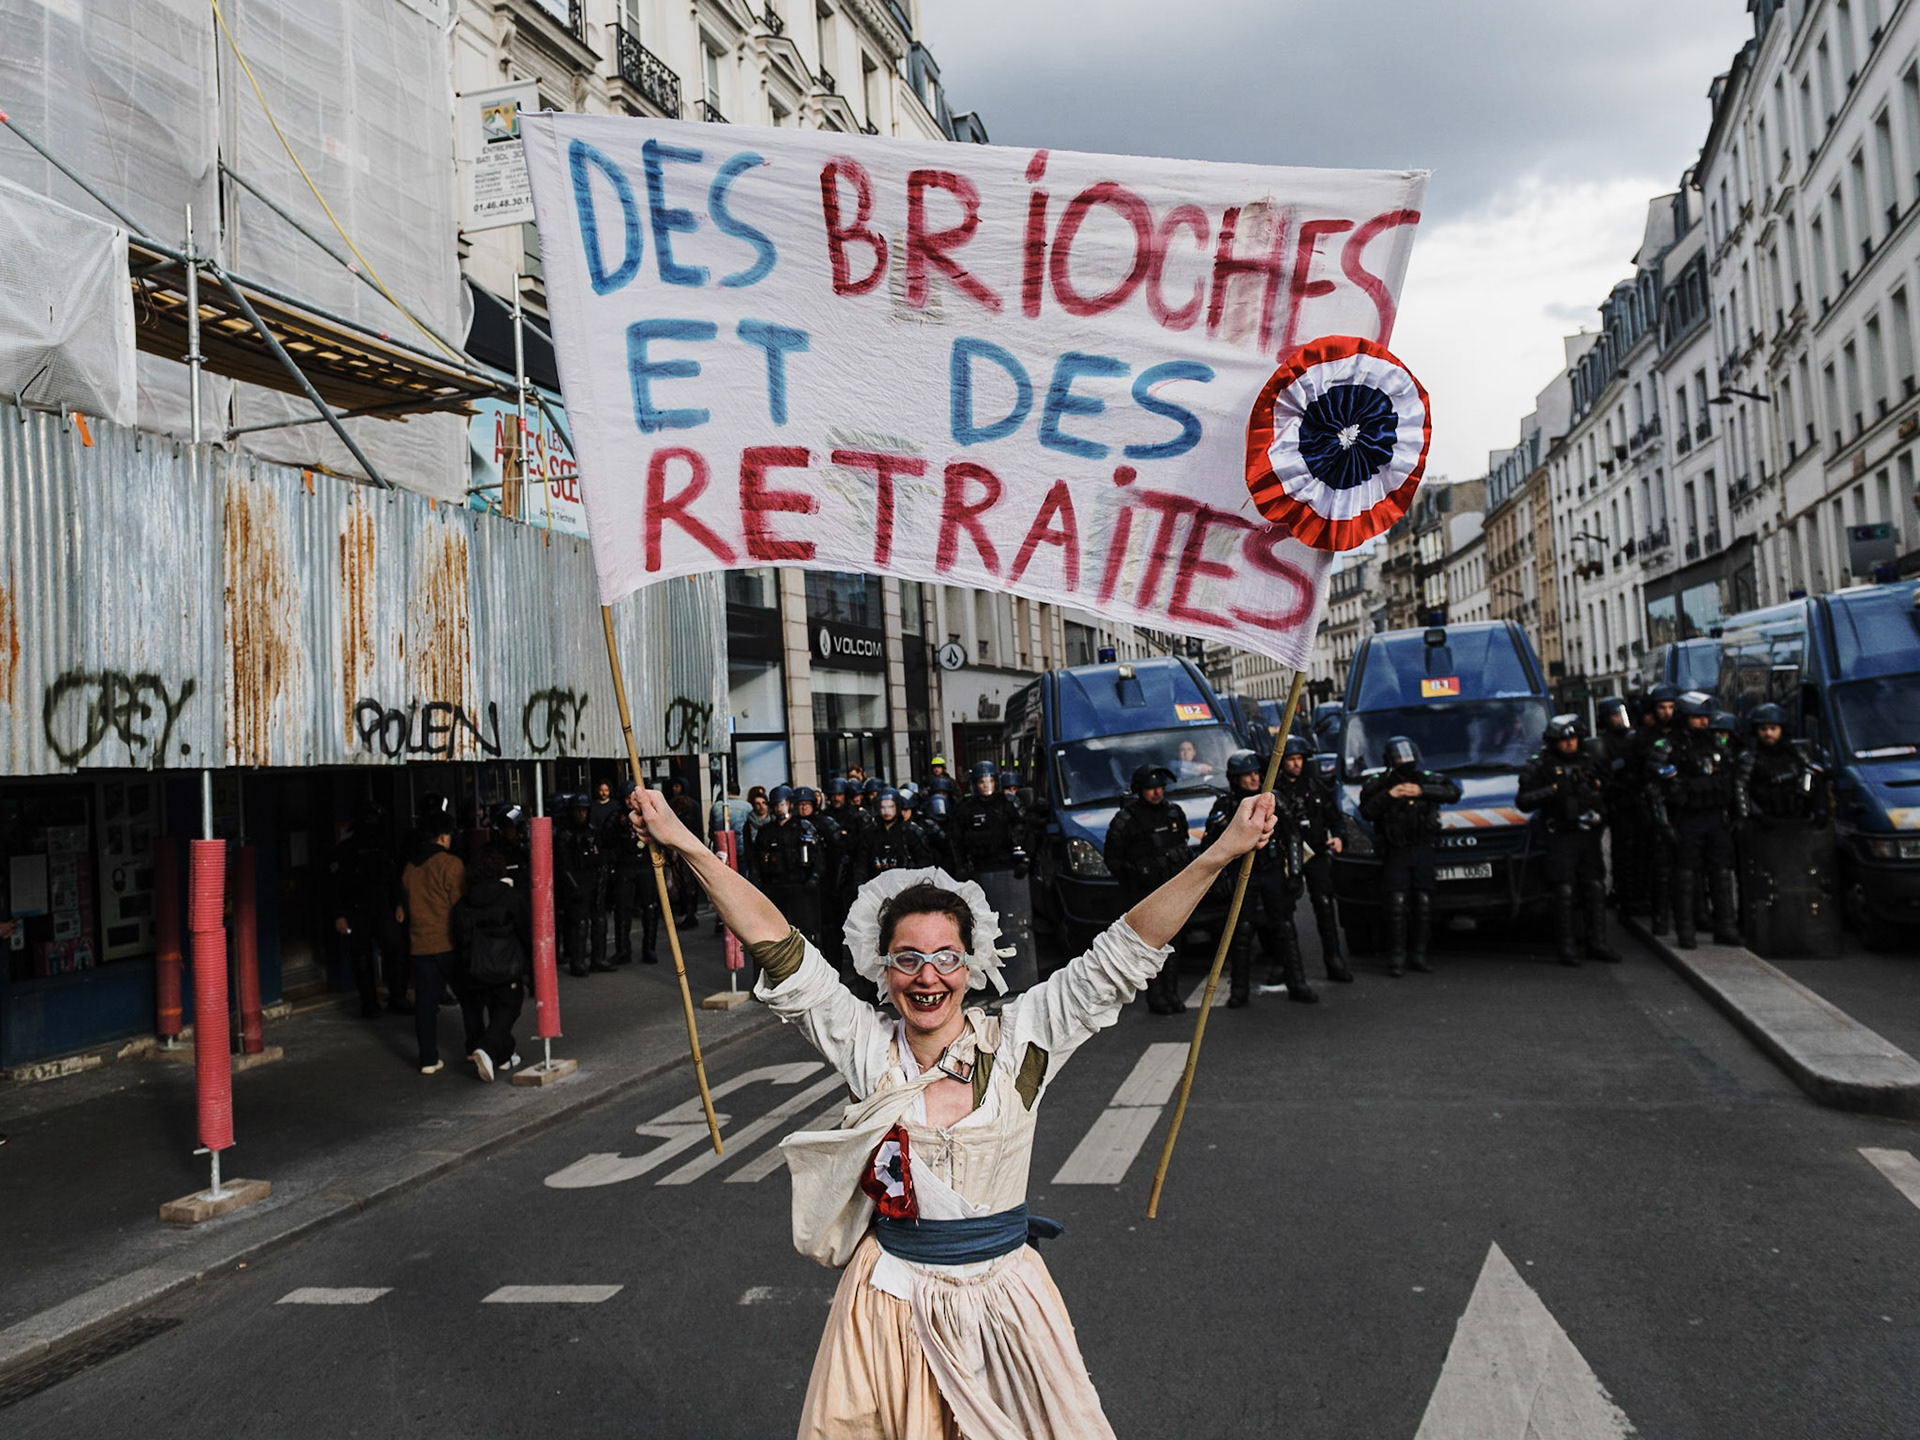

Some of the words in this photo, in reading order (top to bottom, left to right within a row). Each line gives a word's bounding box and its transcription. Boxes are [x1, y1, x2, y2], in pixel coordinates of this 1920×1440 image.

[569, 138, 777, 296] DES
[626, 318, 811, 435] ET
[950, 335, 1216, 460] DES
[547, 428, 563, 453] LES
[833, 636, 882, 656] VOLCOM
[1183, 705, 1202, 715] B2
